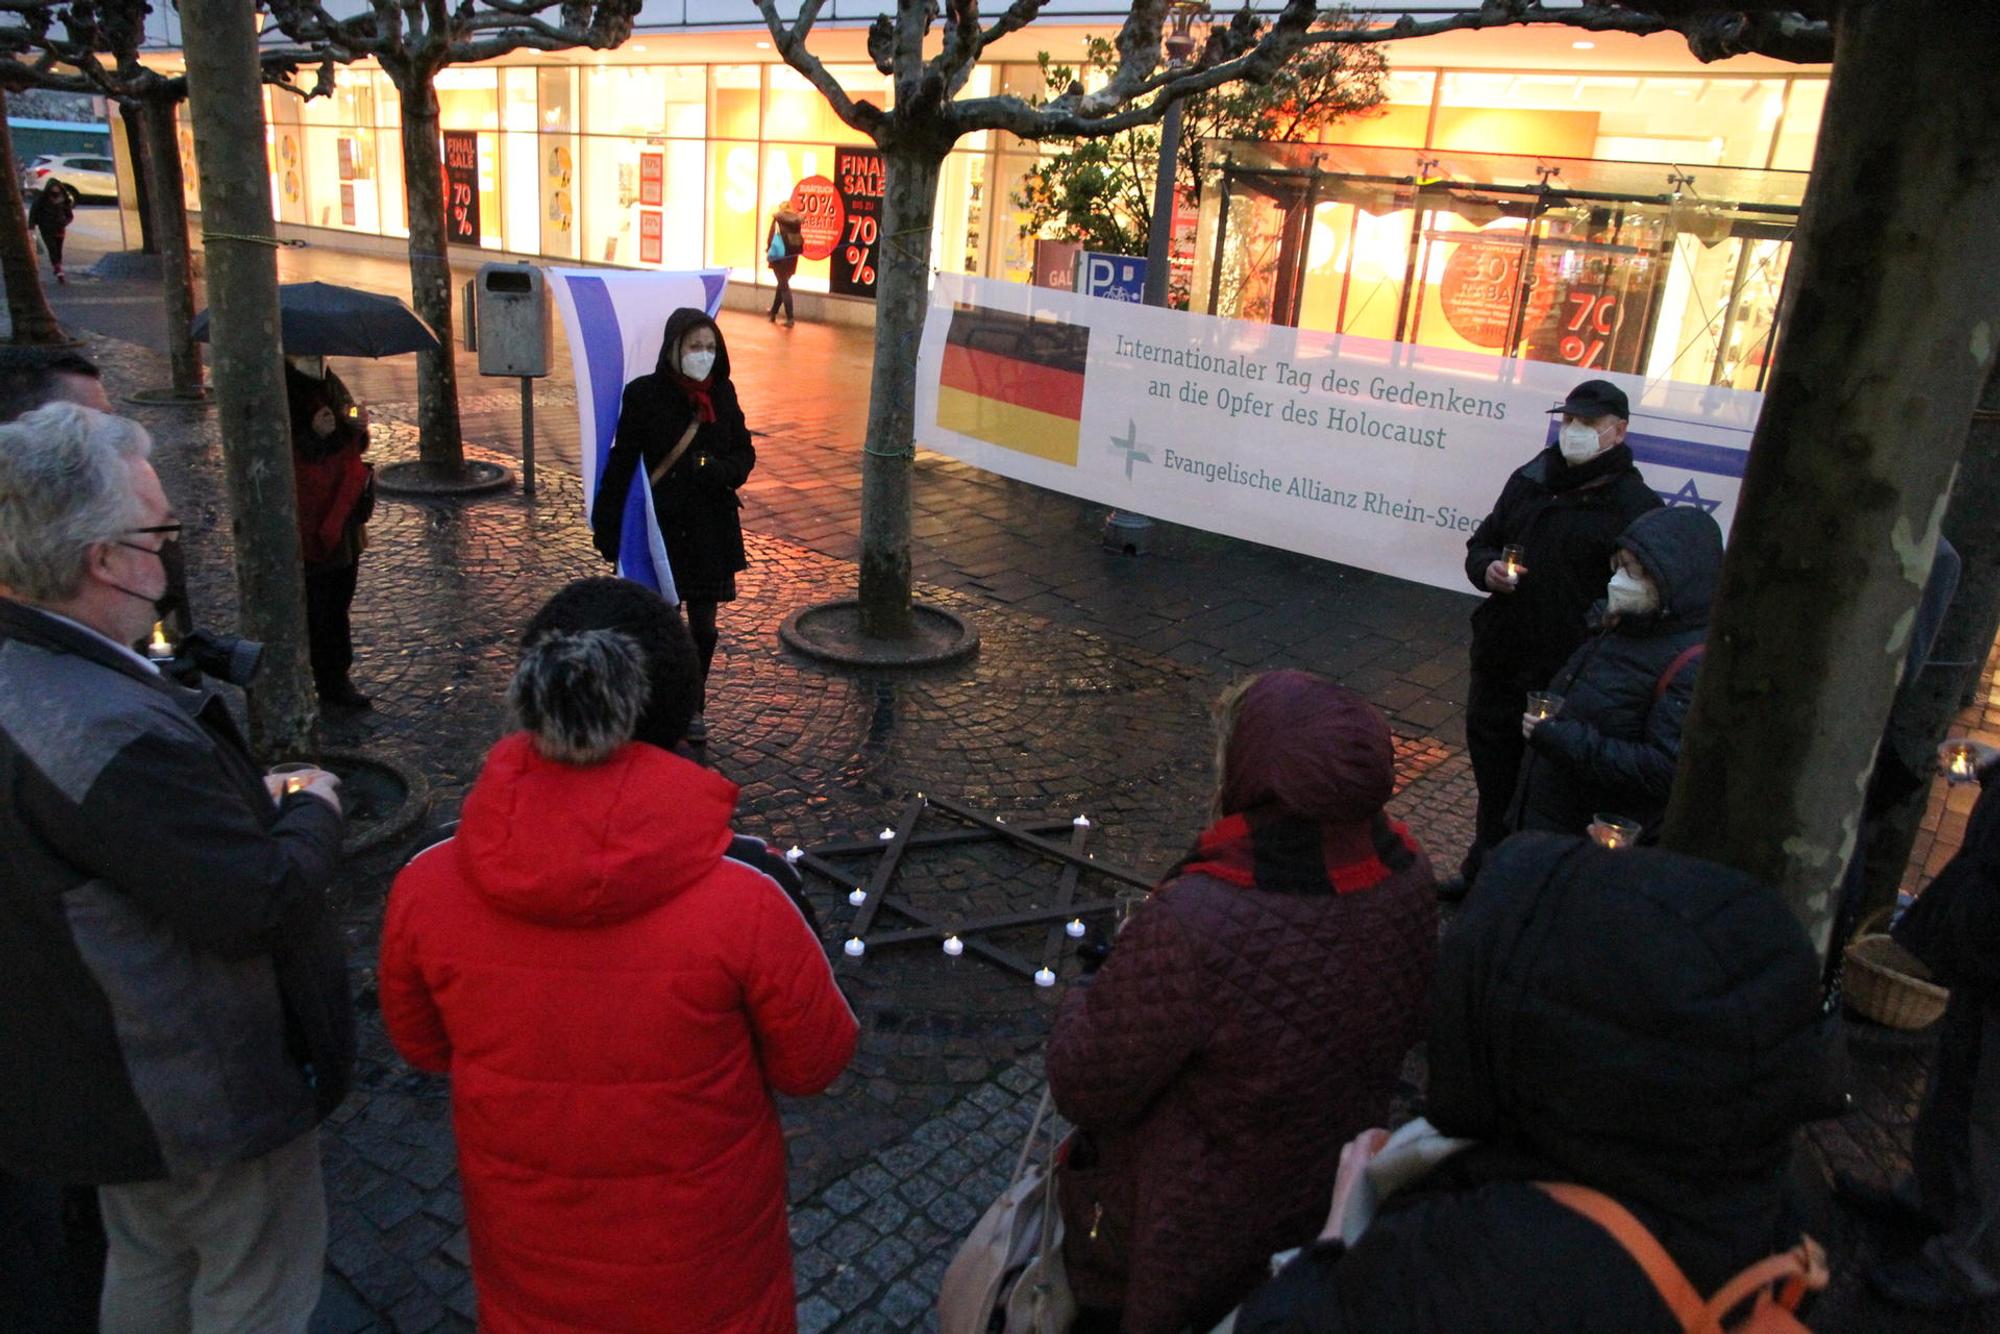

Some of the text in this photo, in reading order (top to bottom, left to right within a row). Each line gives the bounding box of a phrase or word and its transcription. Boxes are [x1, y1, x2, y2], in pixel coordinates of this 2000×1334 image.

[447, 138, 475, 154] FINAL
[449, 152, 474, 169] SALE
[454, 183, 472, 206] 70
[844, 174, 886, 197] SALE
[797, 193, 836, 217] 30%
[454, 206, 473, 236] %
[801, 216, 835, 229] ABATT
[848, 215, 878, 245] 70
[846, 246, 876, 285] %
[1049, 270, 1073, 287] GAL
[1089, 259, 1115, 298] P
[1115, 334, 1507, 420] Internationaler Tag des Gedenkens
[1148, 379, 1447, 449] an die Opfer des Holocaust
[1164, 449, 1282, 492] Evangelische
[1286, 476, 1358, 509] Allianz
